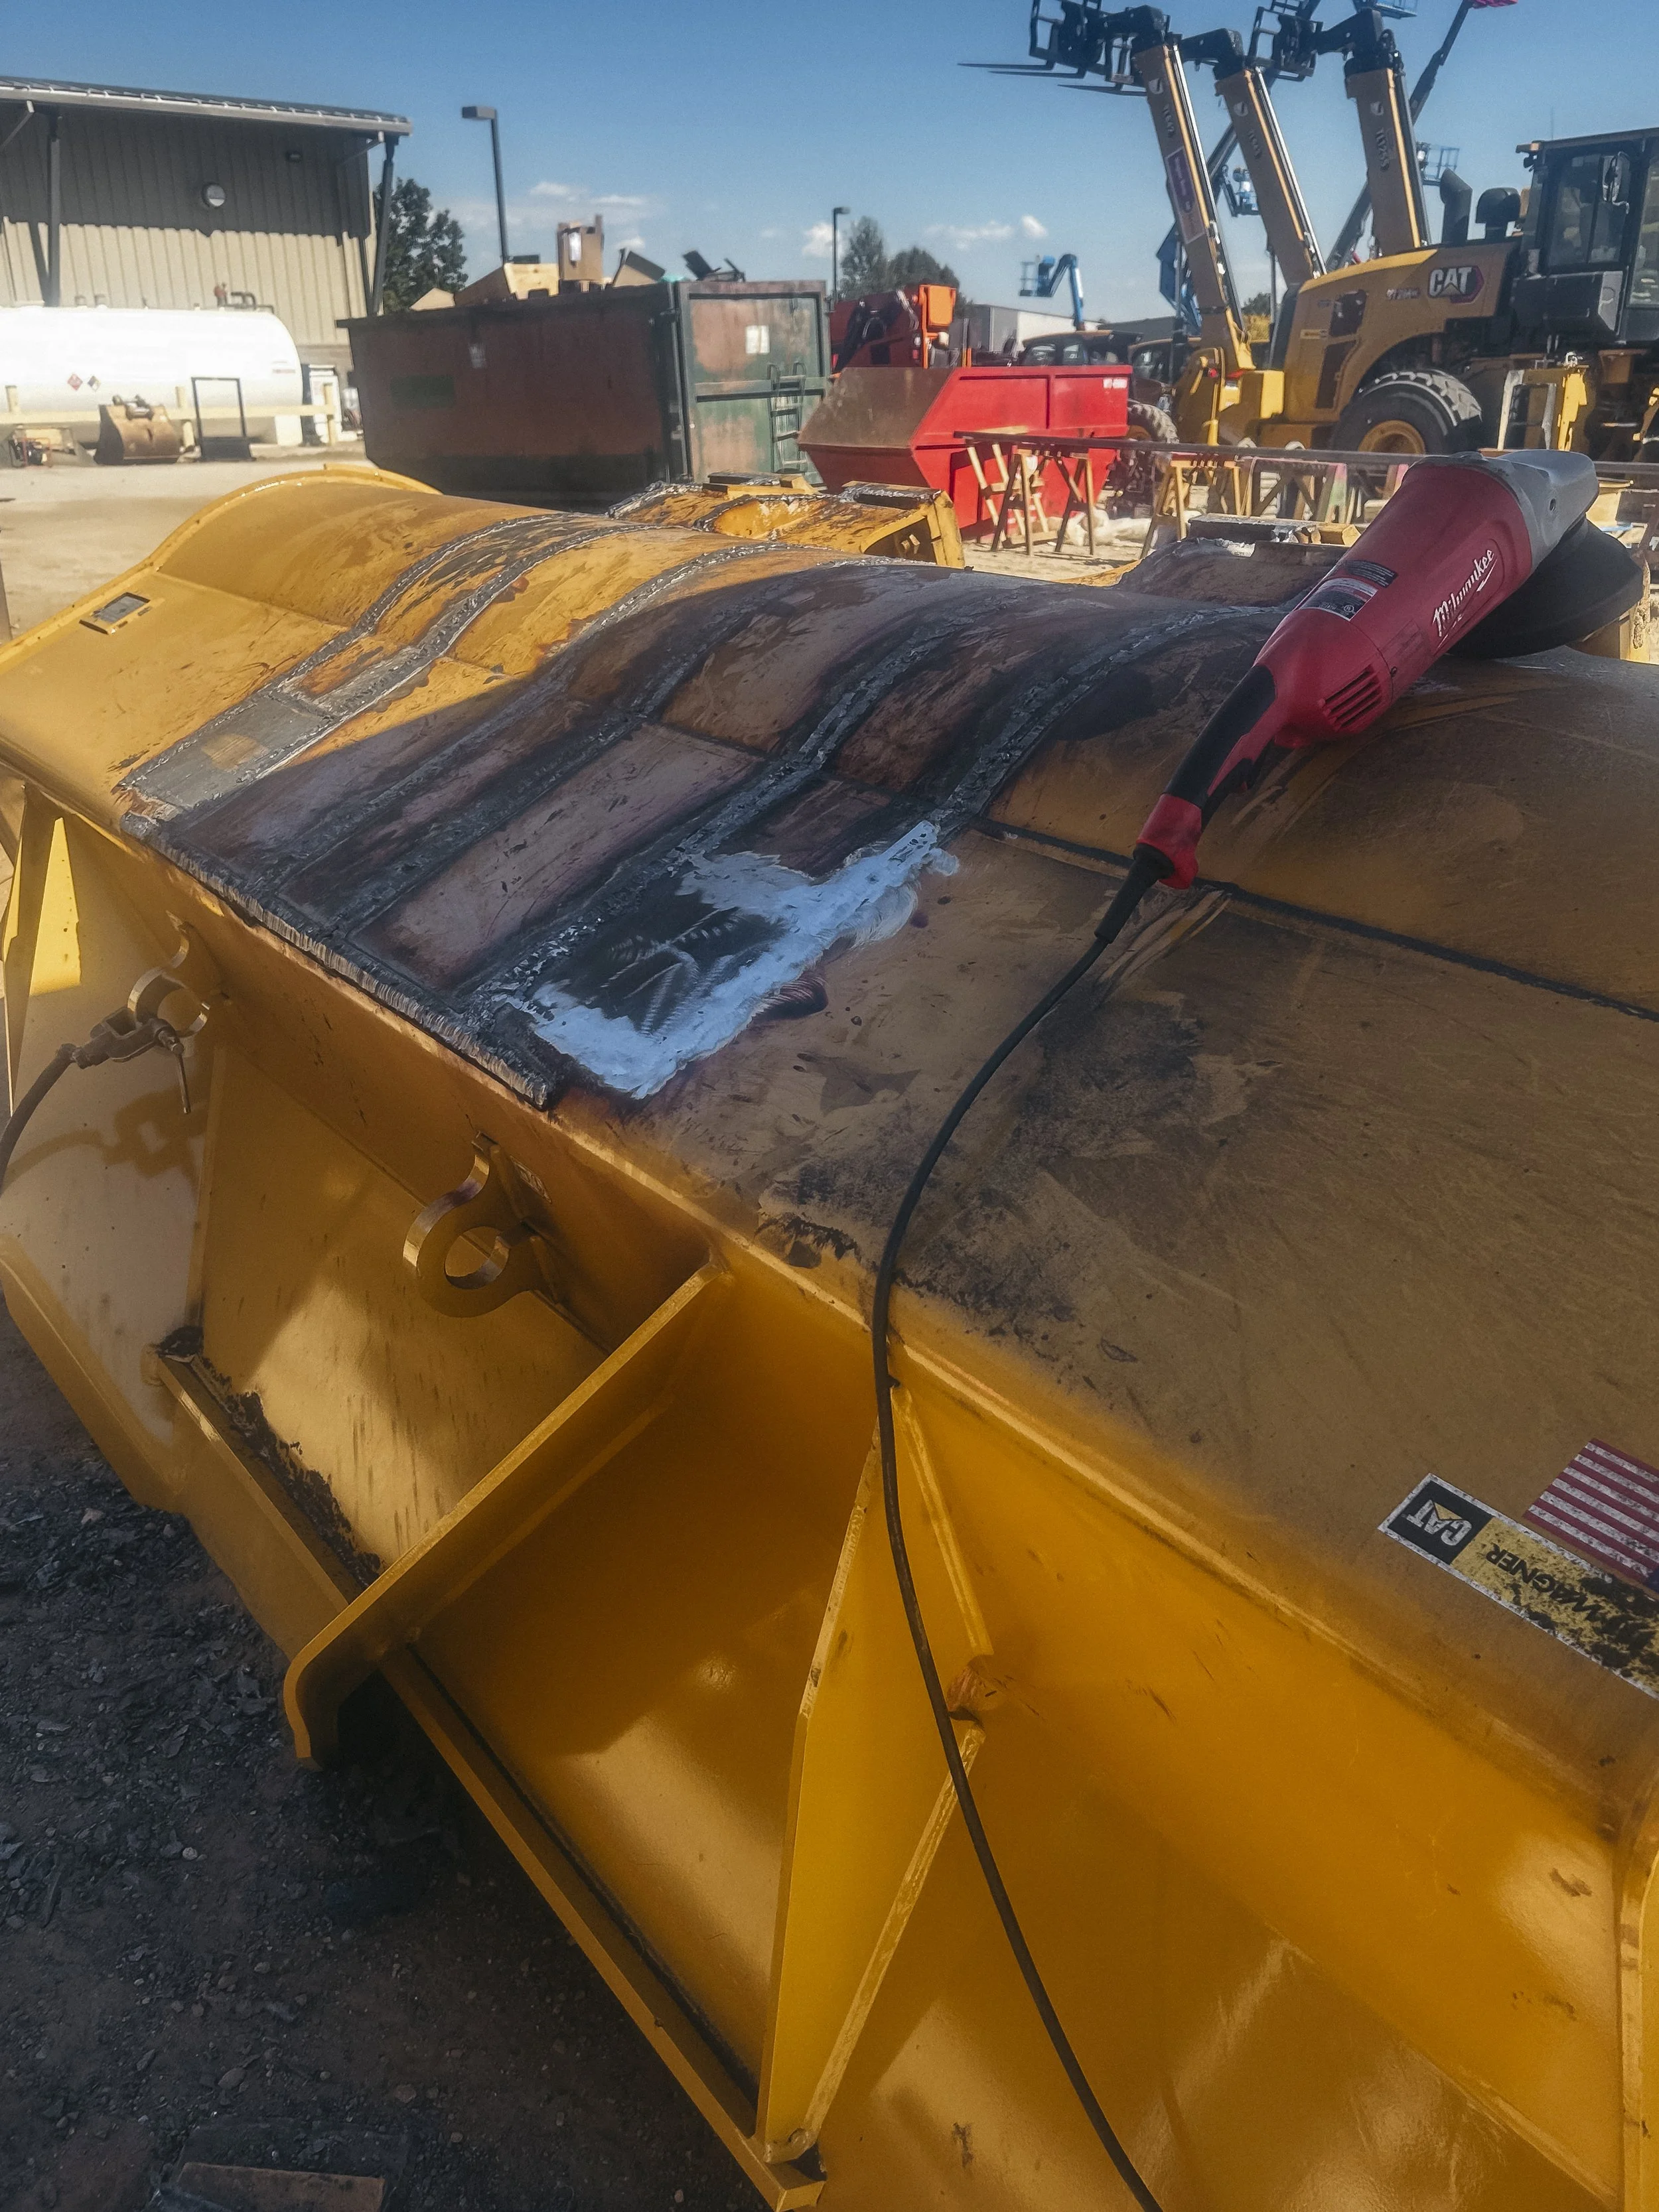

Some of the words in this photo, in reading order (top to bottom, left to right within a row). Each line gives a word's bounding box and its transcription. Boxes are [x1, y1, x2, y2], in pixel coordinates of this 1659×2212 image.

[1429, 266, 1473, 297] CAT
[1432, 549, 1495, 637] Milwaukee
[1404, 1499, 1473, 1547] CAT
[1485, 1543, 1603, 1622] WAGNER
